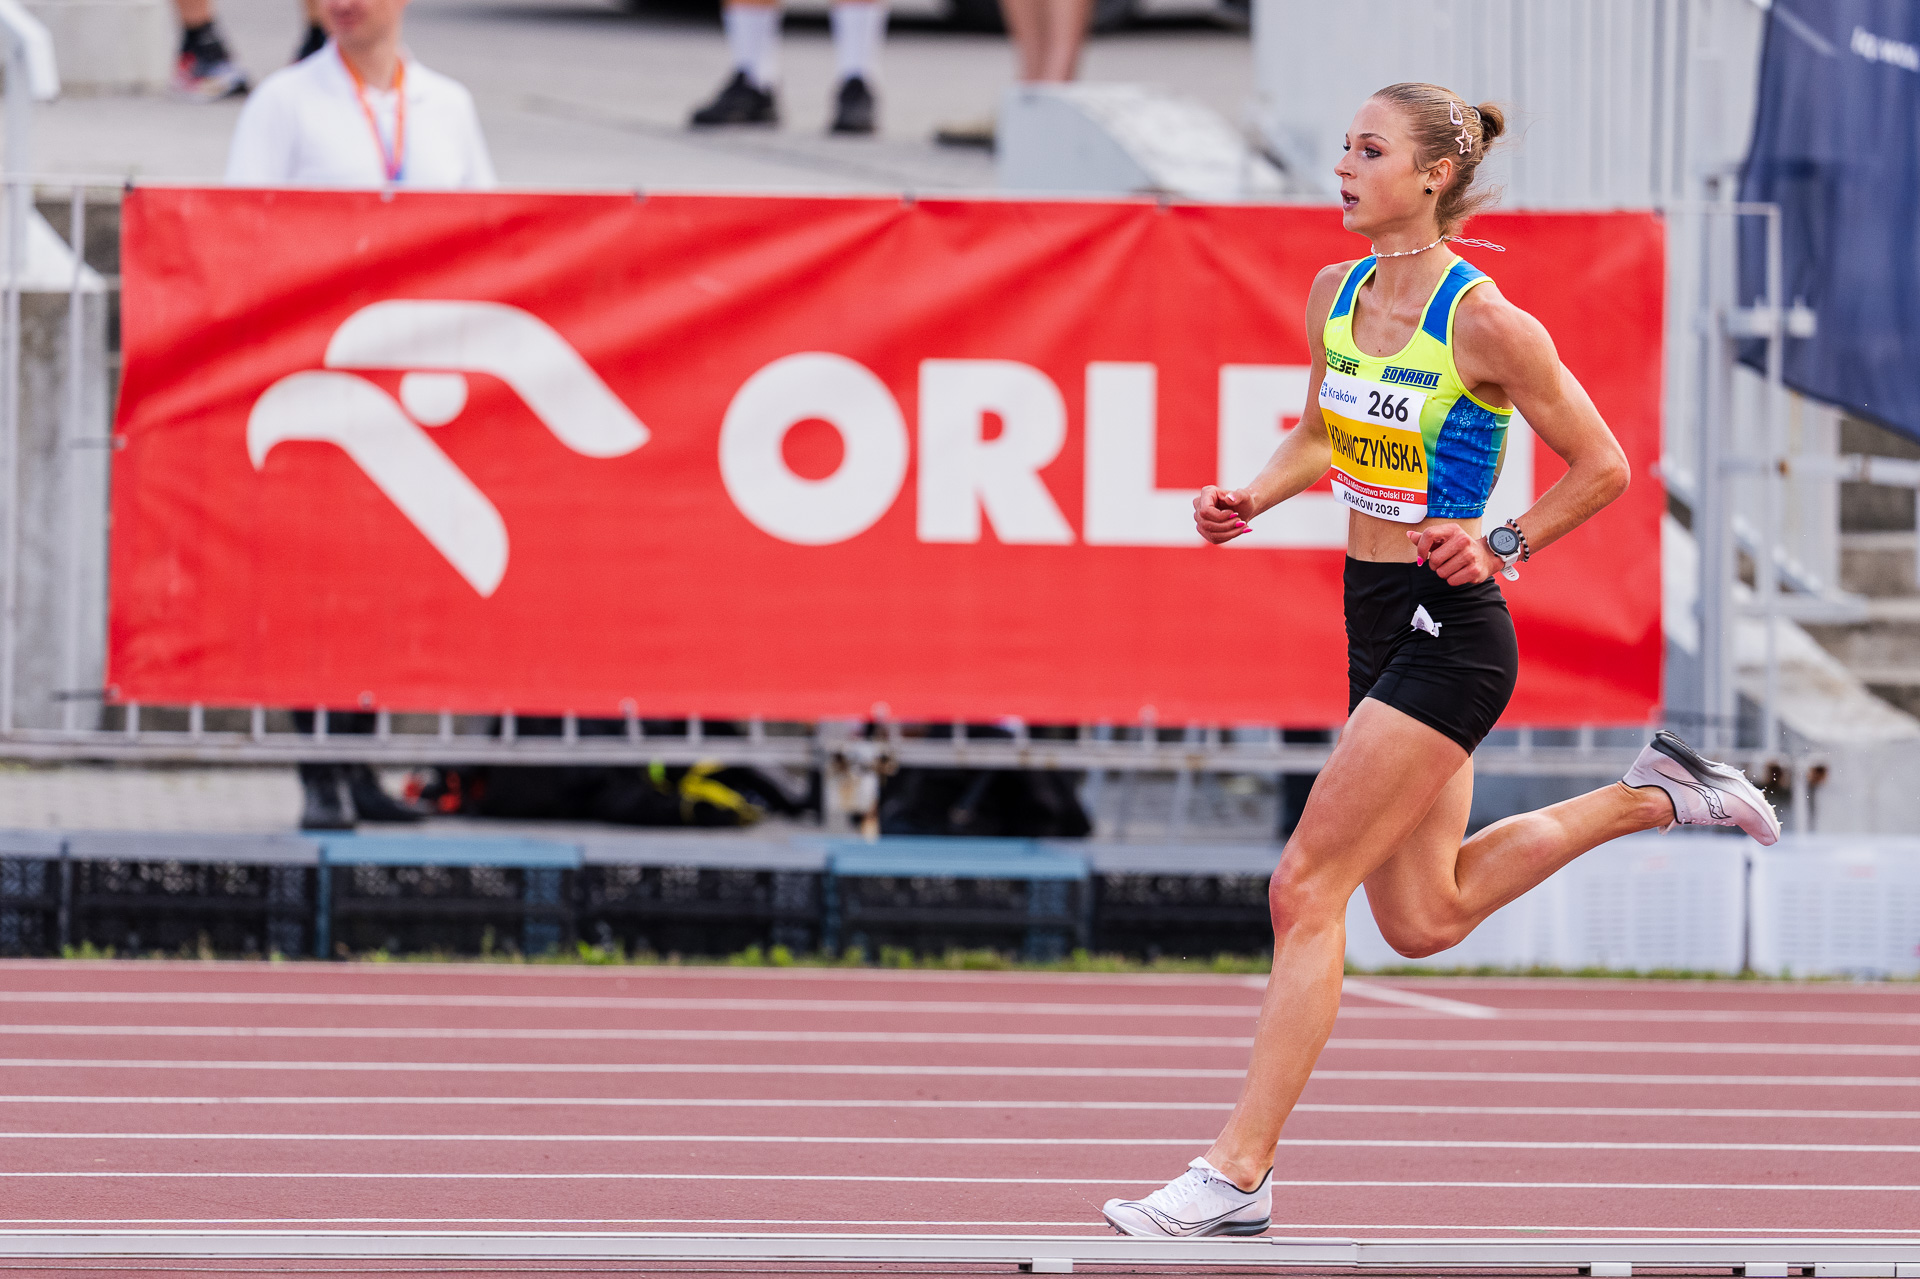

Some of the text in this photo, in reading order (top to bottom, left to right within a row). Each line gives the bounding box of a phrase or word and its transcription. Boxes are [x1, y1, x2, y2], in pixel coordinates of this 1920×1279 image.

[1380, 366, 1442, 389] SONAROL
[1328, 387, 1358, 404] Kraków
[1368, 390, 1409, 422] 266
[719, 353, 1534, 547] ORLE
[1328, 423, 1423, 473] KRAWCZYŃSKA
[1343, 490, 1400, 517] KRAKÓW 2026
[1379, 489, 1400, 500] Polski
[1401, 493, 1415, 502] U23
